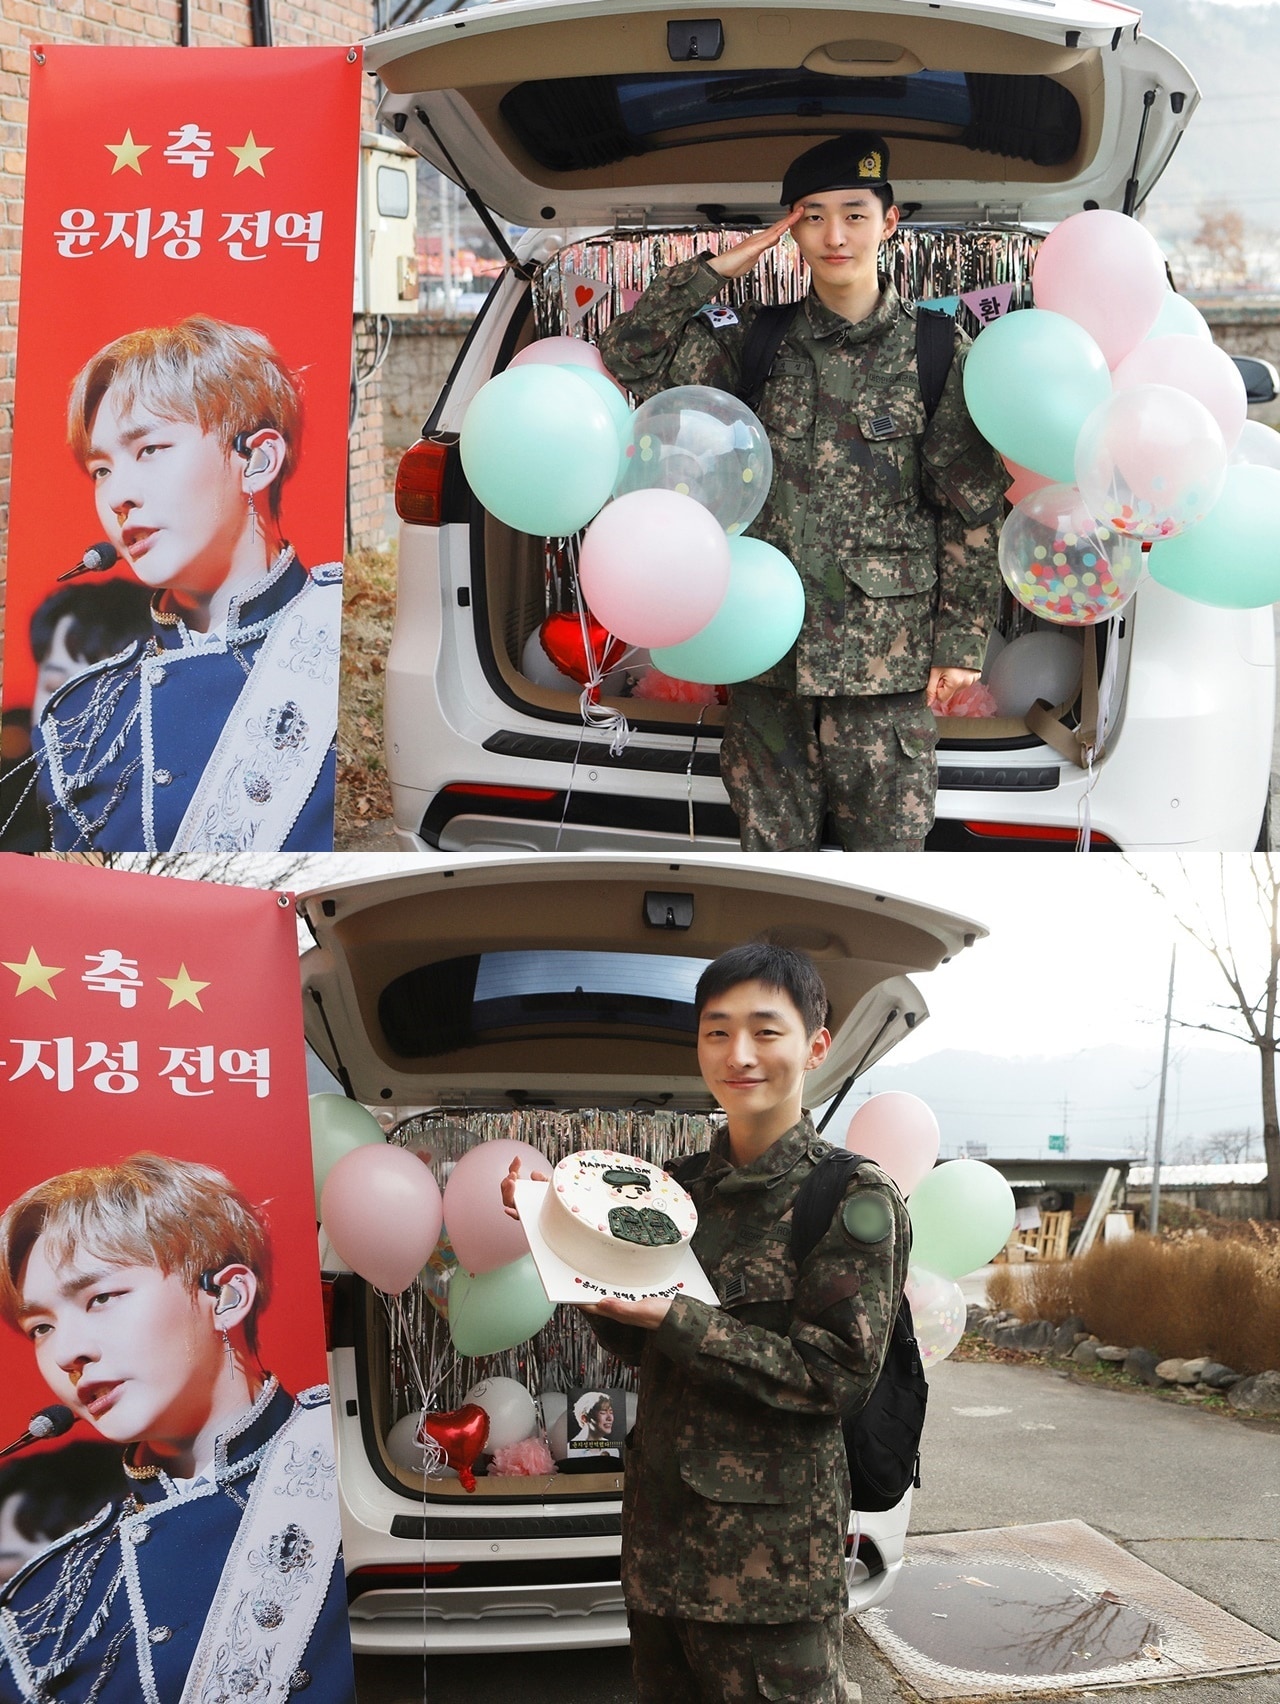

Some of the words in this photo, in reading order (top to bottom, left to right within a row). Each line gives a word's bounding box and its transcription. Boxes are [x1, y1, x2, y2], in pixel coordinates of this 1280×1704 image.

[163, 123, 215, 179] 축
[53, 208, 203, 260] 윤지성
[218, 210, 324, 263] 전역
[979, 297, 1001, 323] 환
[81, 948, 144, 1008] 축
[0, 1036, 139, 1095] 지성
[158, 1046, 271, 1098] 전역
[579, 1160, 613, 1172] HAPPY
